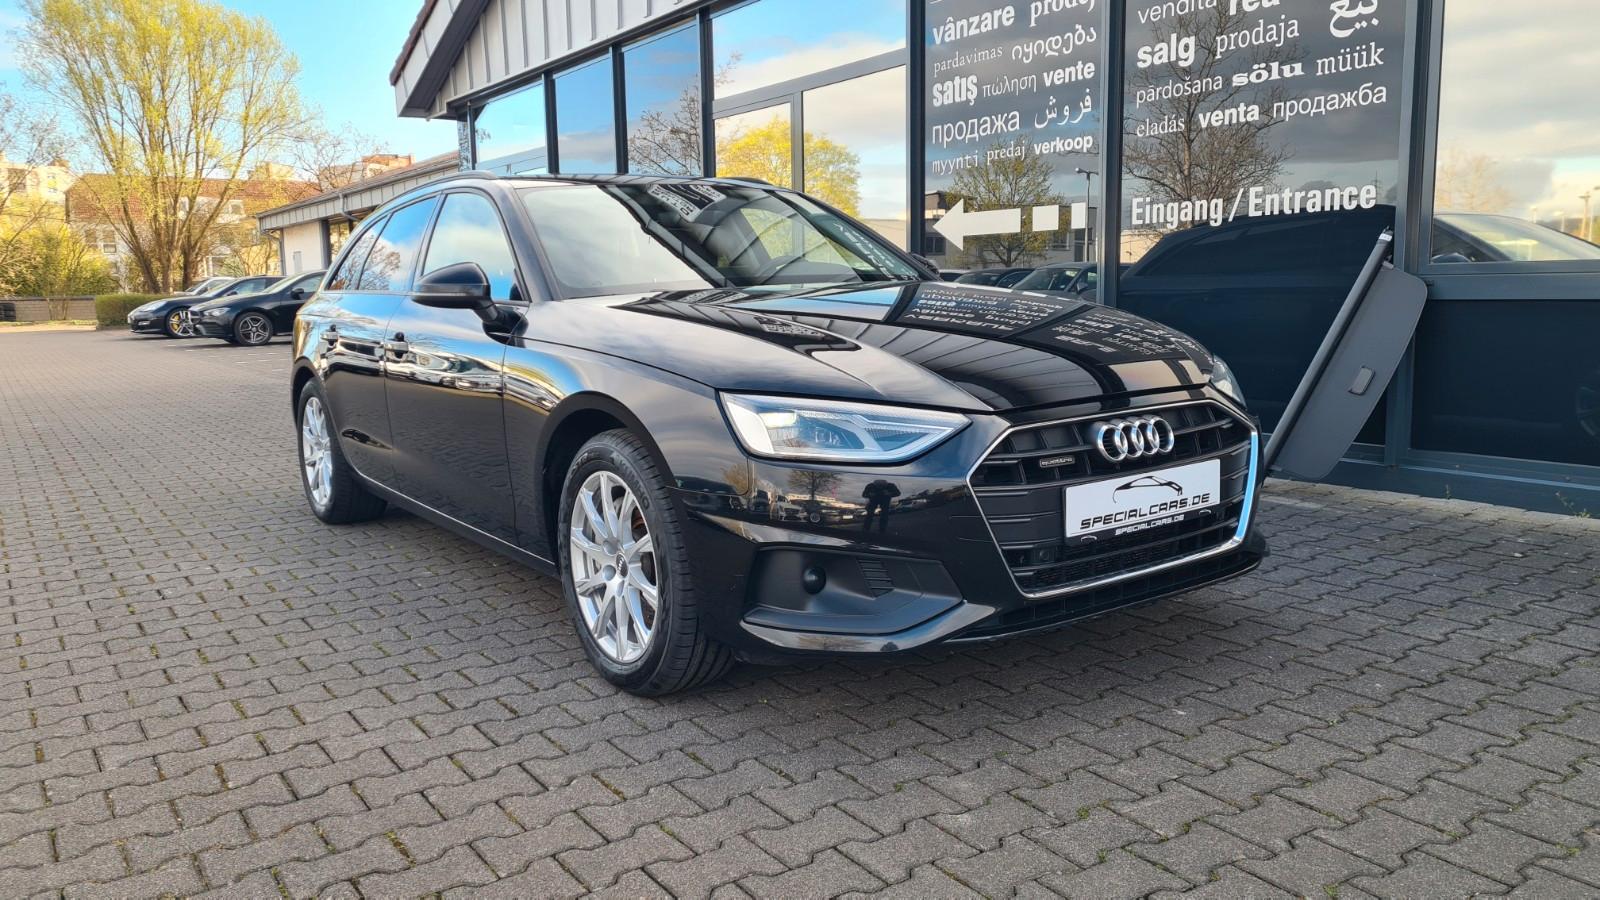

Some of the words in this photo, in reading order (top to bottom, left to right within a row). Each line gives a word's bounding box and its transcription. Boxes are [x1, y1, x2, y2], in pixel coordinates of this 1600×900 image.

[933, 5, 1015, 45] vânzare
[1137, 33, 1196, 68] salg
[1215, 14, 1299, 59] prodaja
[934, 46, 1003, 77] pardavimas
[1043, 60, 1095, 87] vente
[1136, 75, 1223, 108] pārdošana
[1231, 61, 1305, 88] sölu
[1316, 42, 1385, 76] müük
[933, 75, 978, 107] satış
[1273, 82, 1387, 122] продажба
[932, 110, 1020, 149] продажа
[1136, 115, 1185, 137] eladás
[1199, 102, 1260, 128] venta
[932, 152, 978, 176] myynti
[987, 141, 1025, 165] predaj
[1034, 135, 1093, 155] verkoop
[1131, 196, 1223, 229] Eingang
[1248, 184, 1377, 217] Entrance
[1079, 493, 1211, 530] SPECIALCARS.DE
